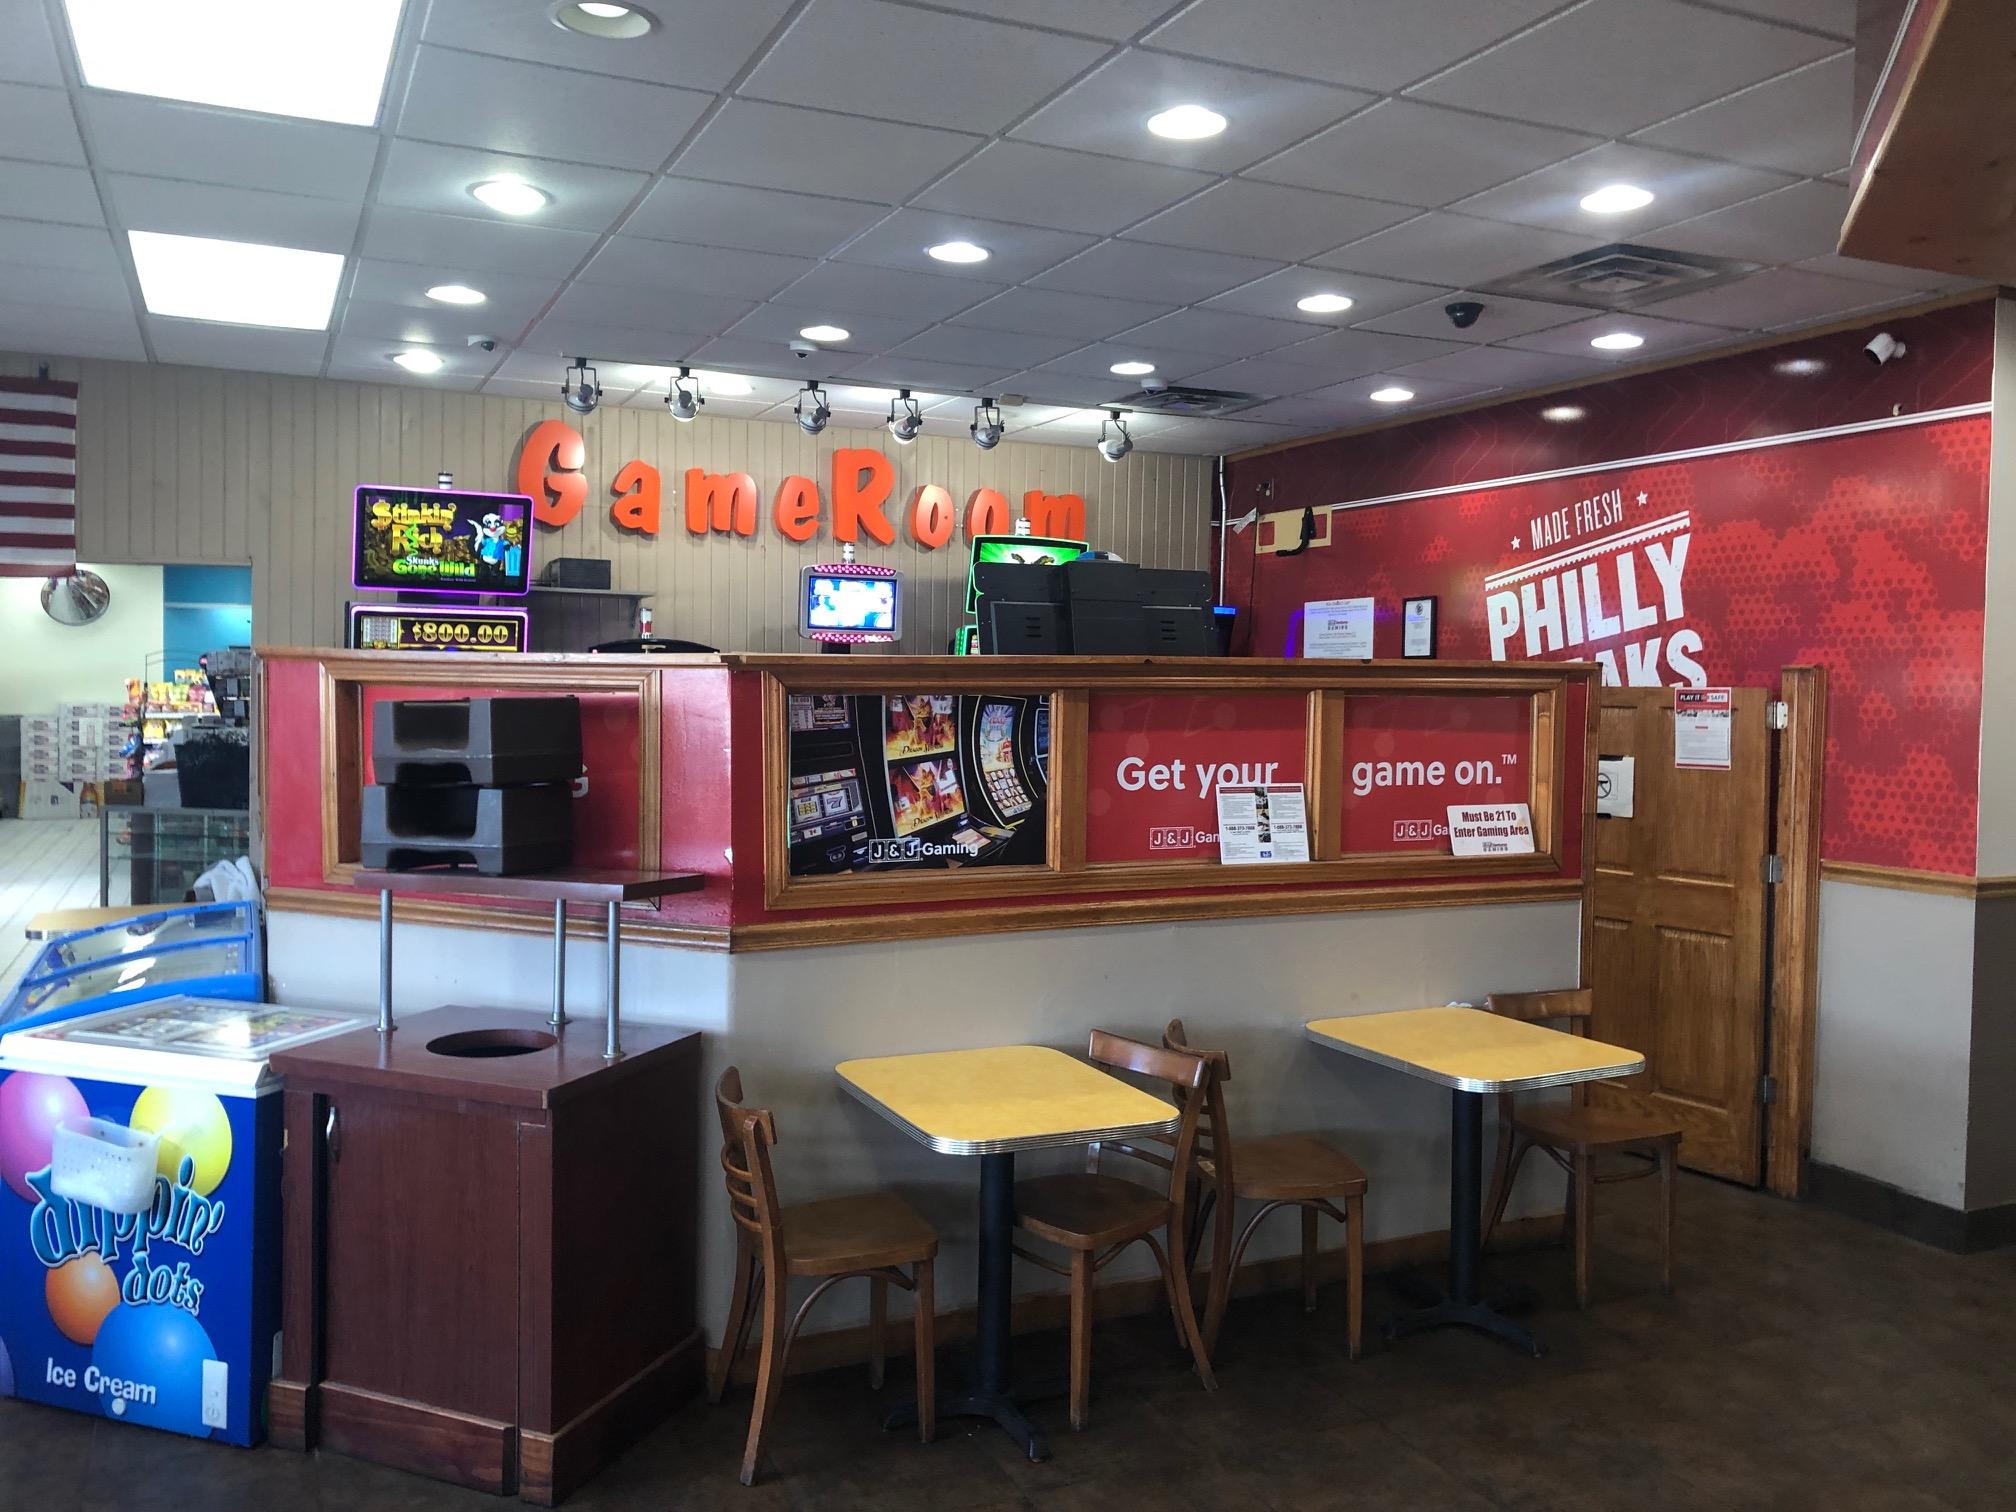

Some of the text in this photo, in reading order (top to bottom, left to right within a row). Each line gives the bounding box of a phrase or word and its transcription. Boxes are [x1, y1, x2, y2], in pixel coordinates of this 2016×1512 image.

[1530, 488, 1623, 550] MADE FRESH
[390, 524, 443, 555] Rich
[406, 555, 438, 566] Skunks
[1486, 533, 1691, 661] PHILLY
[412, 622, 509, 643] $800.00
[1117, 757, 1278, 799] Get your
[1352, 760, 1445, 796] game
[1454, 827, 1475, 838] Enter
[1477, 826, 1508, 837] Gaming
[1509, 825, 1529, 836] Area
[1462, 810, 1516, 822] Must Be 21 To
[921, 841, 979, 857] Gaming
[123, 1251, 204, 1316] dots
[46, 1356, 156, 1405] Ice Cream
